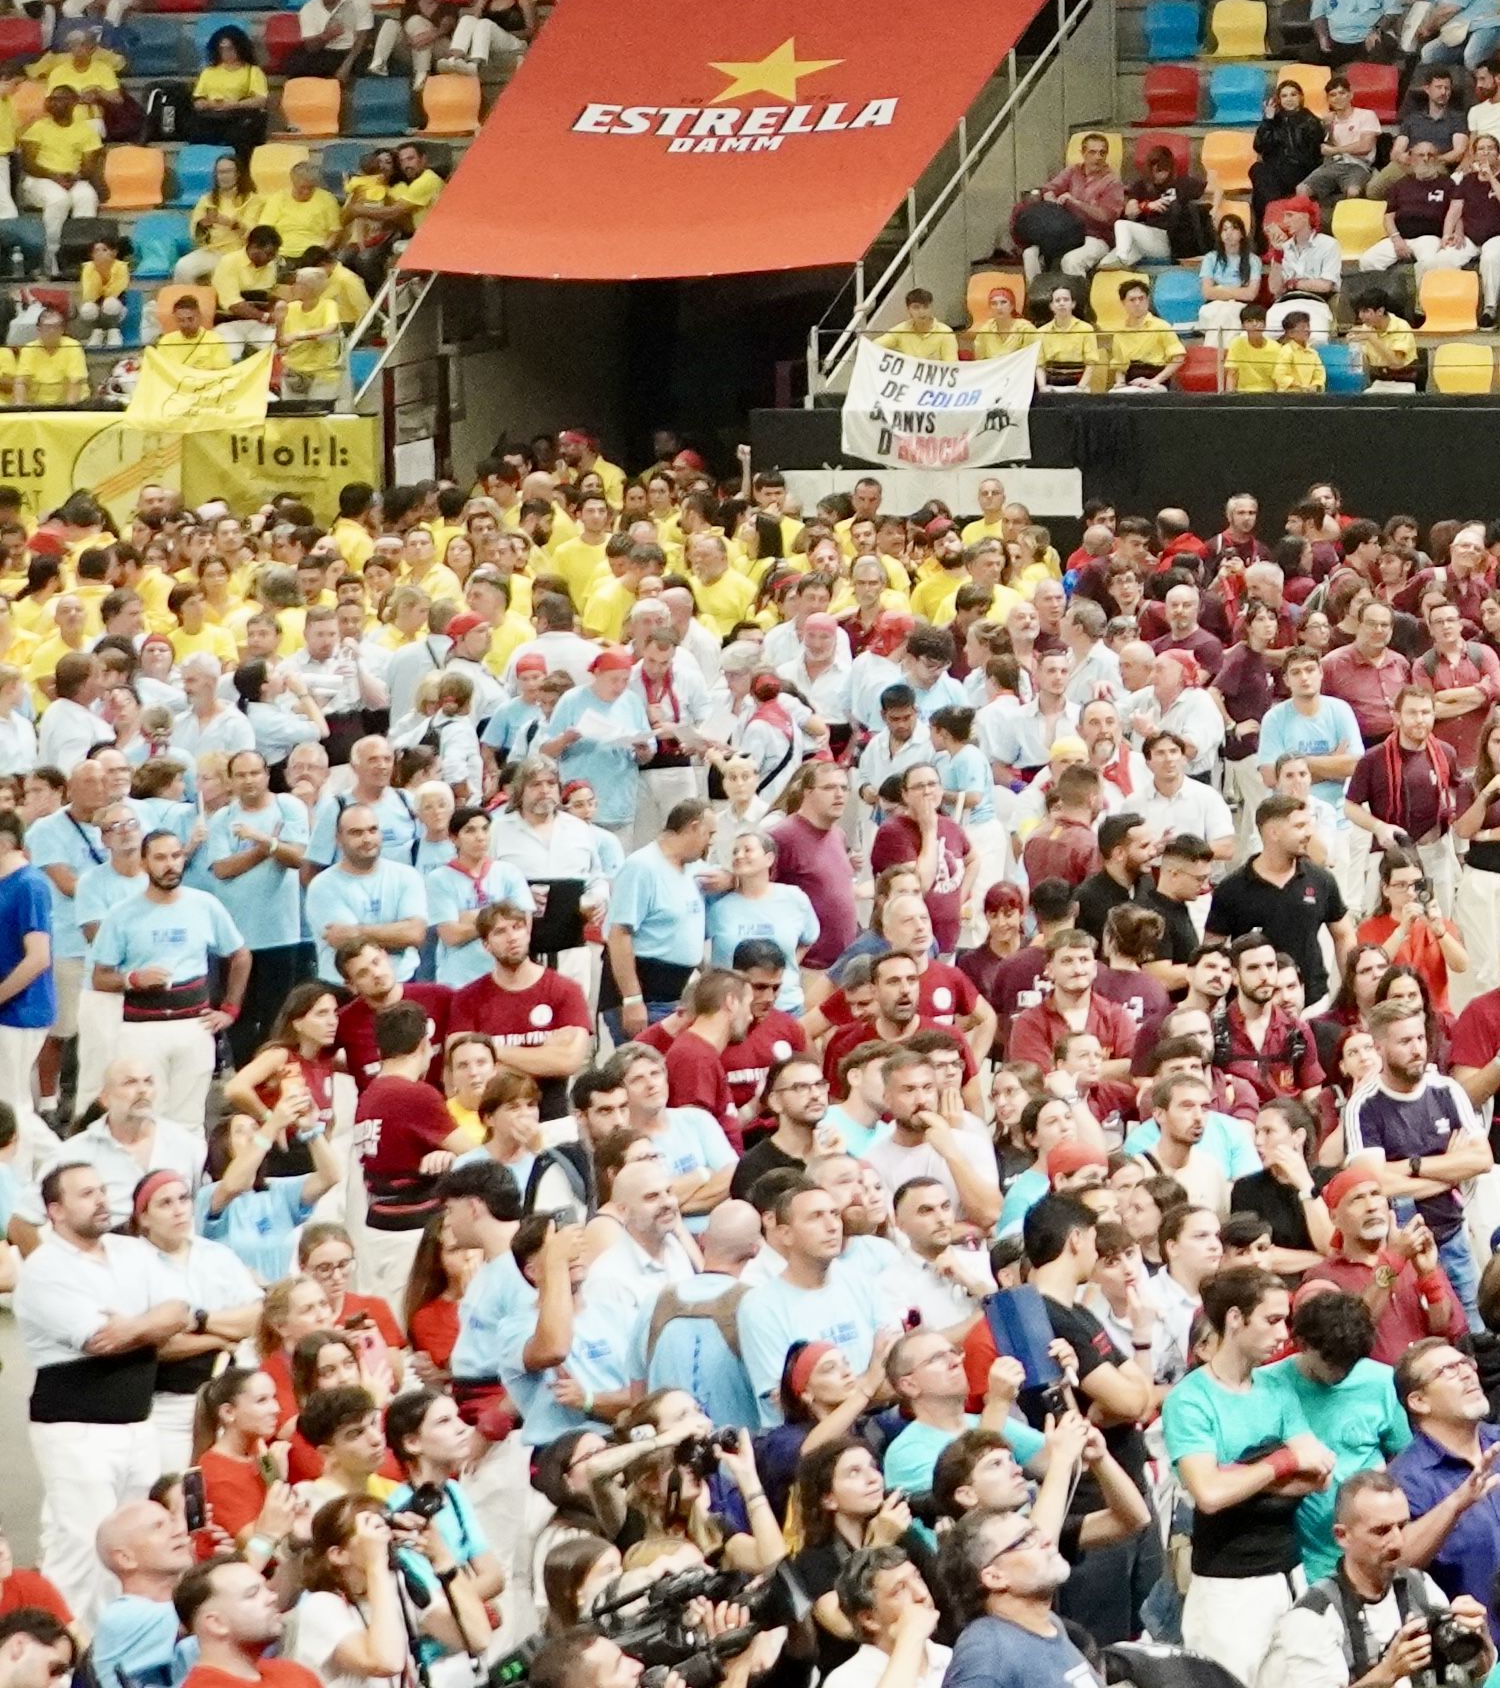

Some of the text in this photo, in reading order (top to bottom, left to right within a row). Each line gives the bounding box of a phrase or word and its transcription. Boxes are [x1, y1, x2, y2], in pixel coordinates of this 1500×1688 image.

[572, 97, 899, 136] ESTRELLA
[668, 135, 782, 153] DAMM
[879, 354, 959, 388] 50 ANYS
[881, 380, 982, 408] DE COLOR
